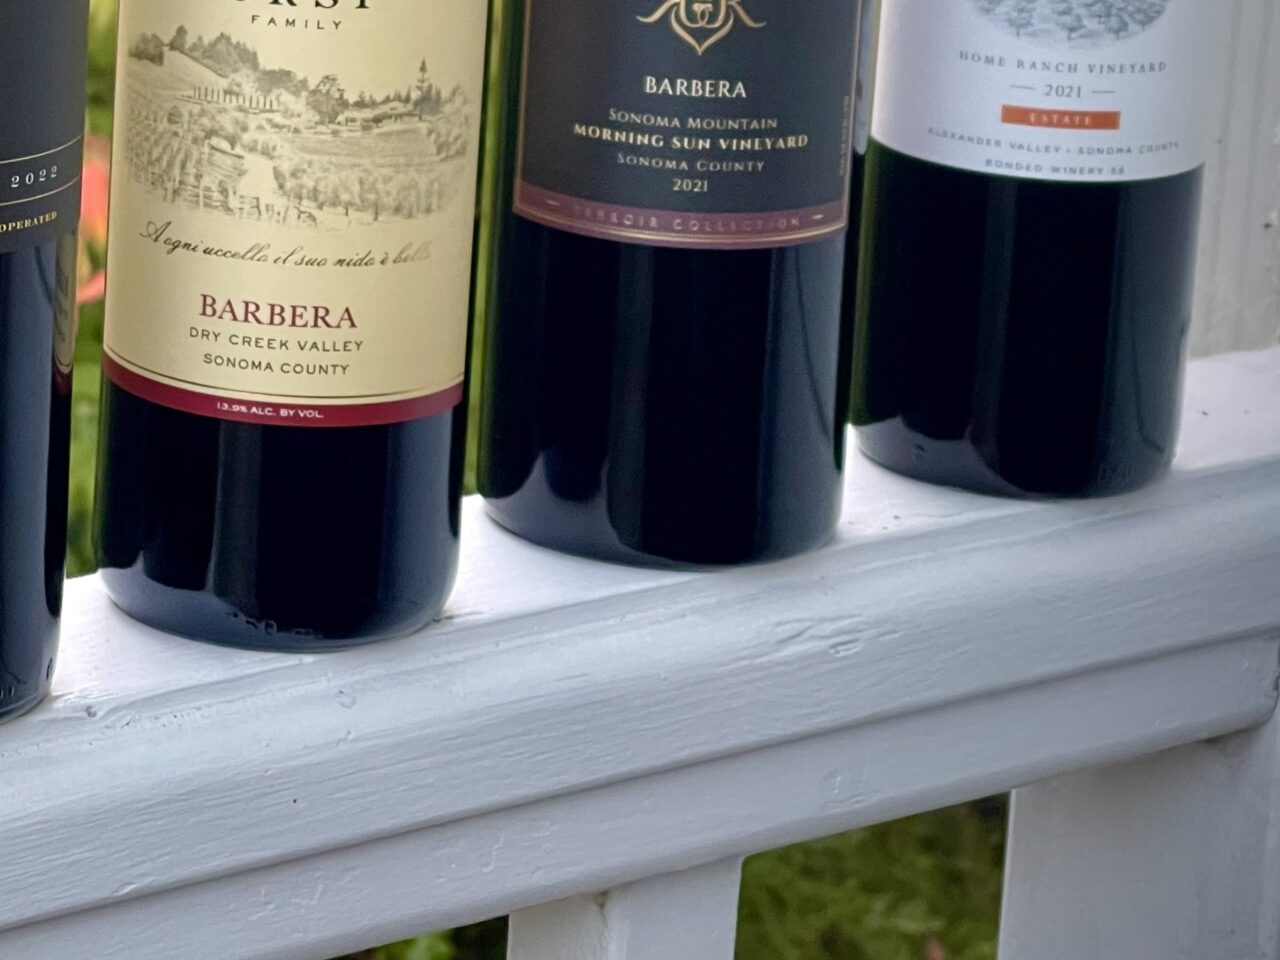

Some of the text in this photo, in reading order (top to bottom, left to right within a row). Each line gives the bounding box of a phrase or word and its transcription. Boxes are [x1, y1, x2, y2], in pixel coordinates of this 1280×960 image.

[251, 14, 342, 31] FAMILY
[958, 49, 1168, 76] HOME RANCH VINEYARD
[645, 75, 747, 99] BARBERA
[1044, 83, 1083, 99] 2021
[607, 107, 778, 131] SONOMA MOUNTAIN
[1029, 112, 1093, 127] ESTATE
[573, 123, 809, 152] MORNING SUN VINEYARD
[927, 127, 1002, 149] ALEXANDER
[1009, 141, 1061, 154] VALLEY
[1078, 145, 1132, 156] SONOMA
[617, 151, 765, 173] SONOMA COUNTY
[1050, 164, 1104, 176] WINERY
[10, 165, 59, 188] 2022
[672, 178, 709, 193] 2021
[139, 220, 173, 243] A
[163, 237, 199, 254] ogni
[273, 246, 297, 265] il
[294, 253, 328, 267] suo
[332, 249, 376, 267] nido
[199, 293, 358, 329] BARBERA
[189, 326, 364, 353] DRY CREEK VALLEY
[203, 353, 350, 376] SONOMA COUNTY
[250, 406, 276, 416] ALC.
[280, 408, 296, 417] BY
